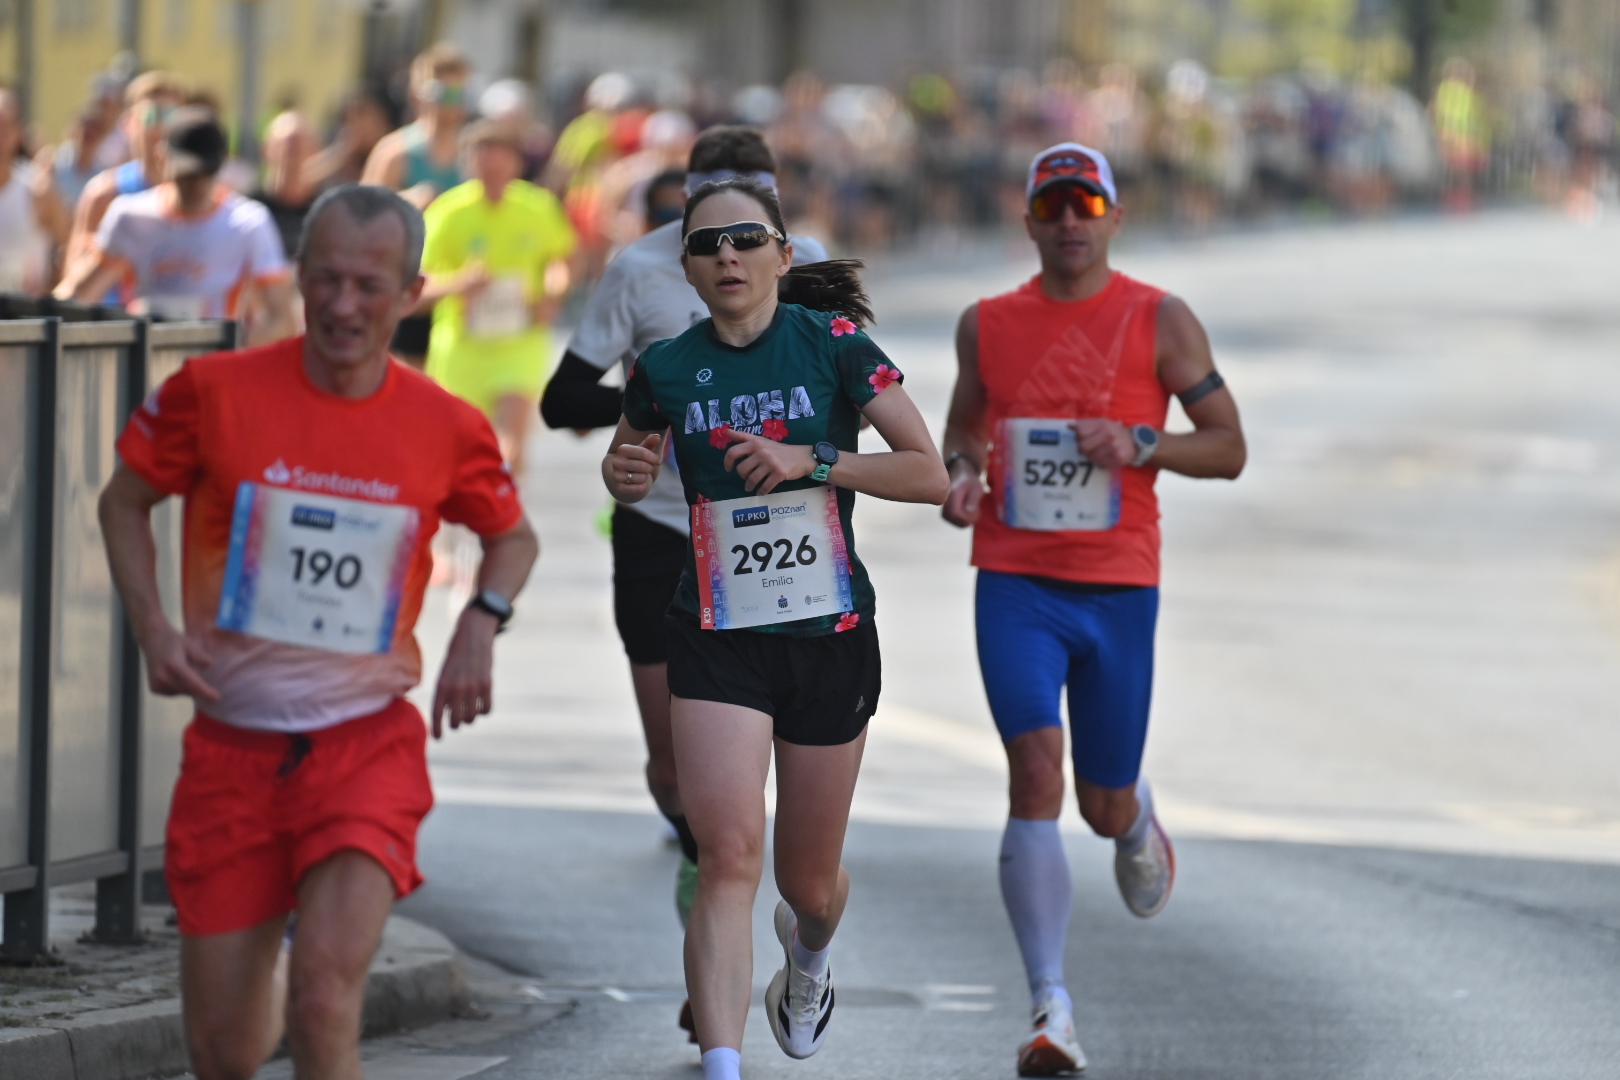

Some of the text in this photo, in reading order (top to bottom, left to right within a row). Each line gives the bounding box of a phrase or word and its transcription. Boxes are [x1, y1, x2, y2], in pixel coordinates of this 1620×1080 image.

[685, 385, 815, 435] ALOHA
[292, 465, 399, 500] Santander
[1024, 459, 1094, 487] 5297
[290, 546, 362, 590] 190
[730, 534, 817, 576] 2926
[761, 575, 794, 589] Emilia
[703, 607, 712, 624] K30
